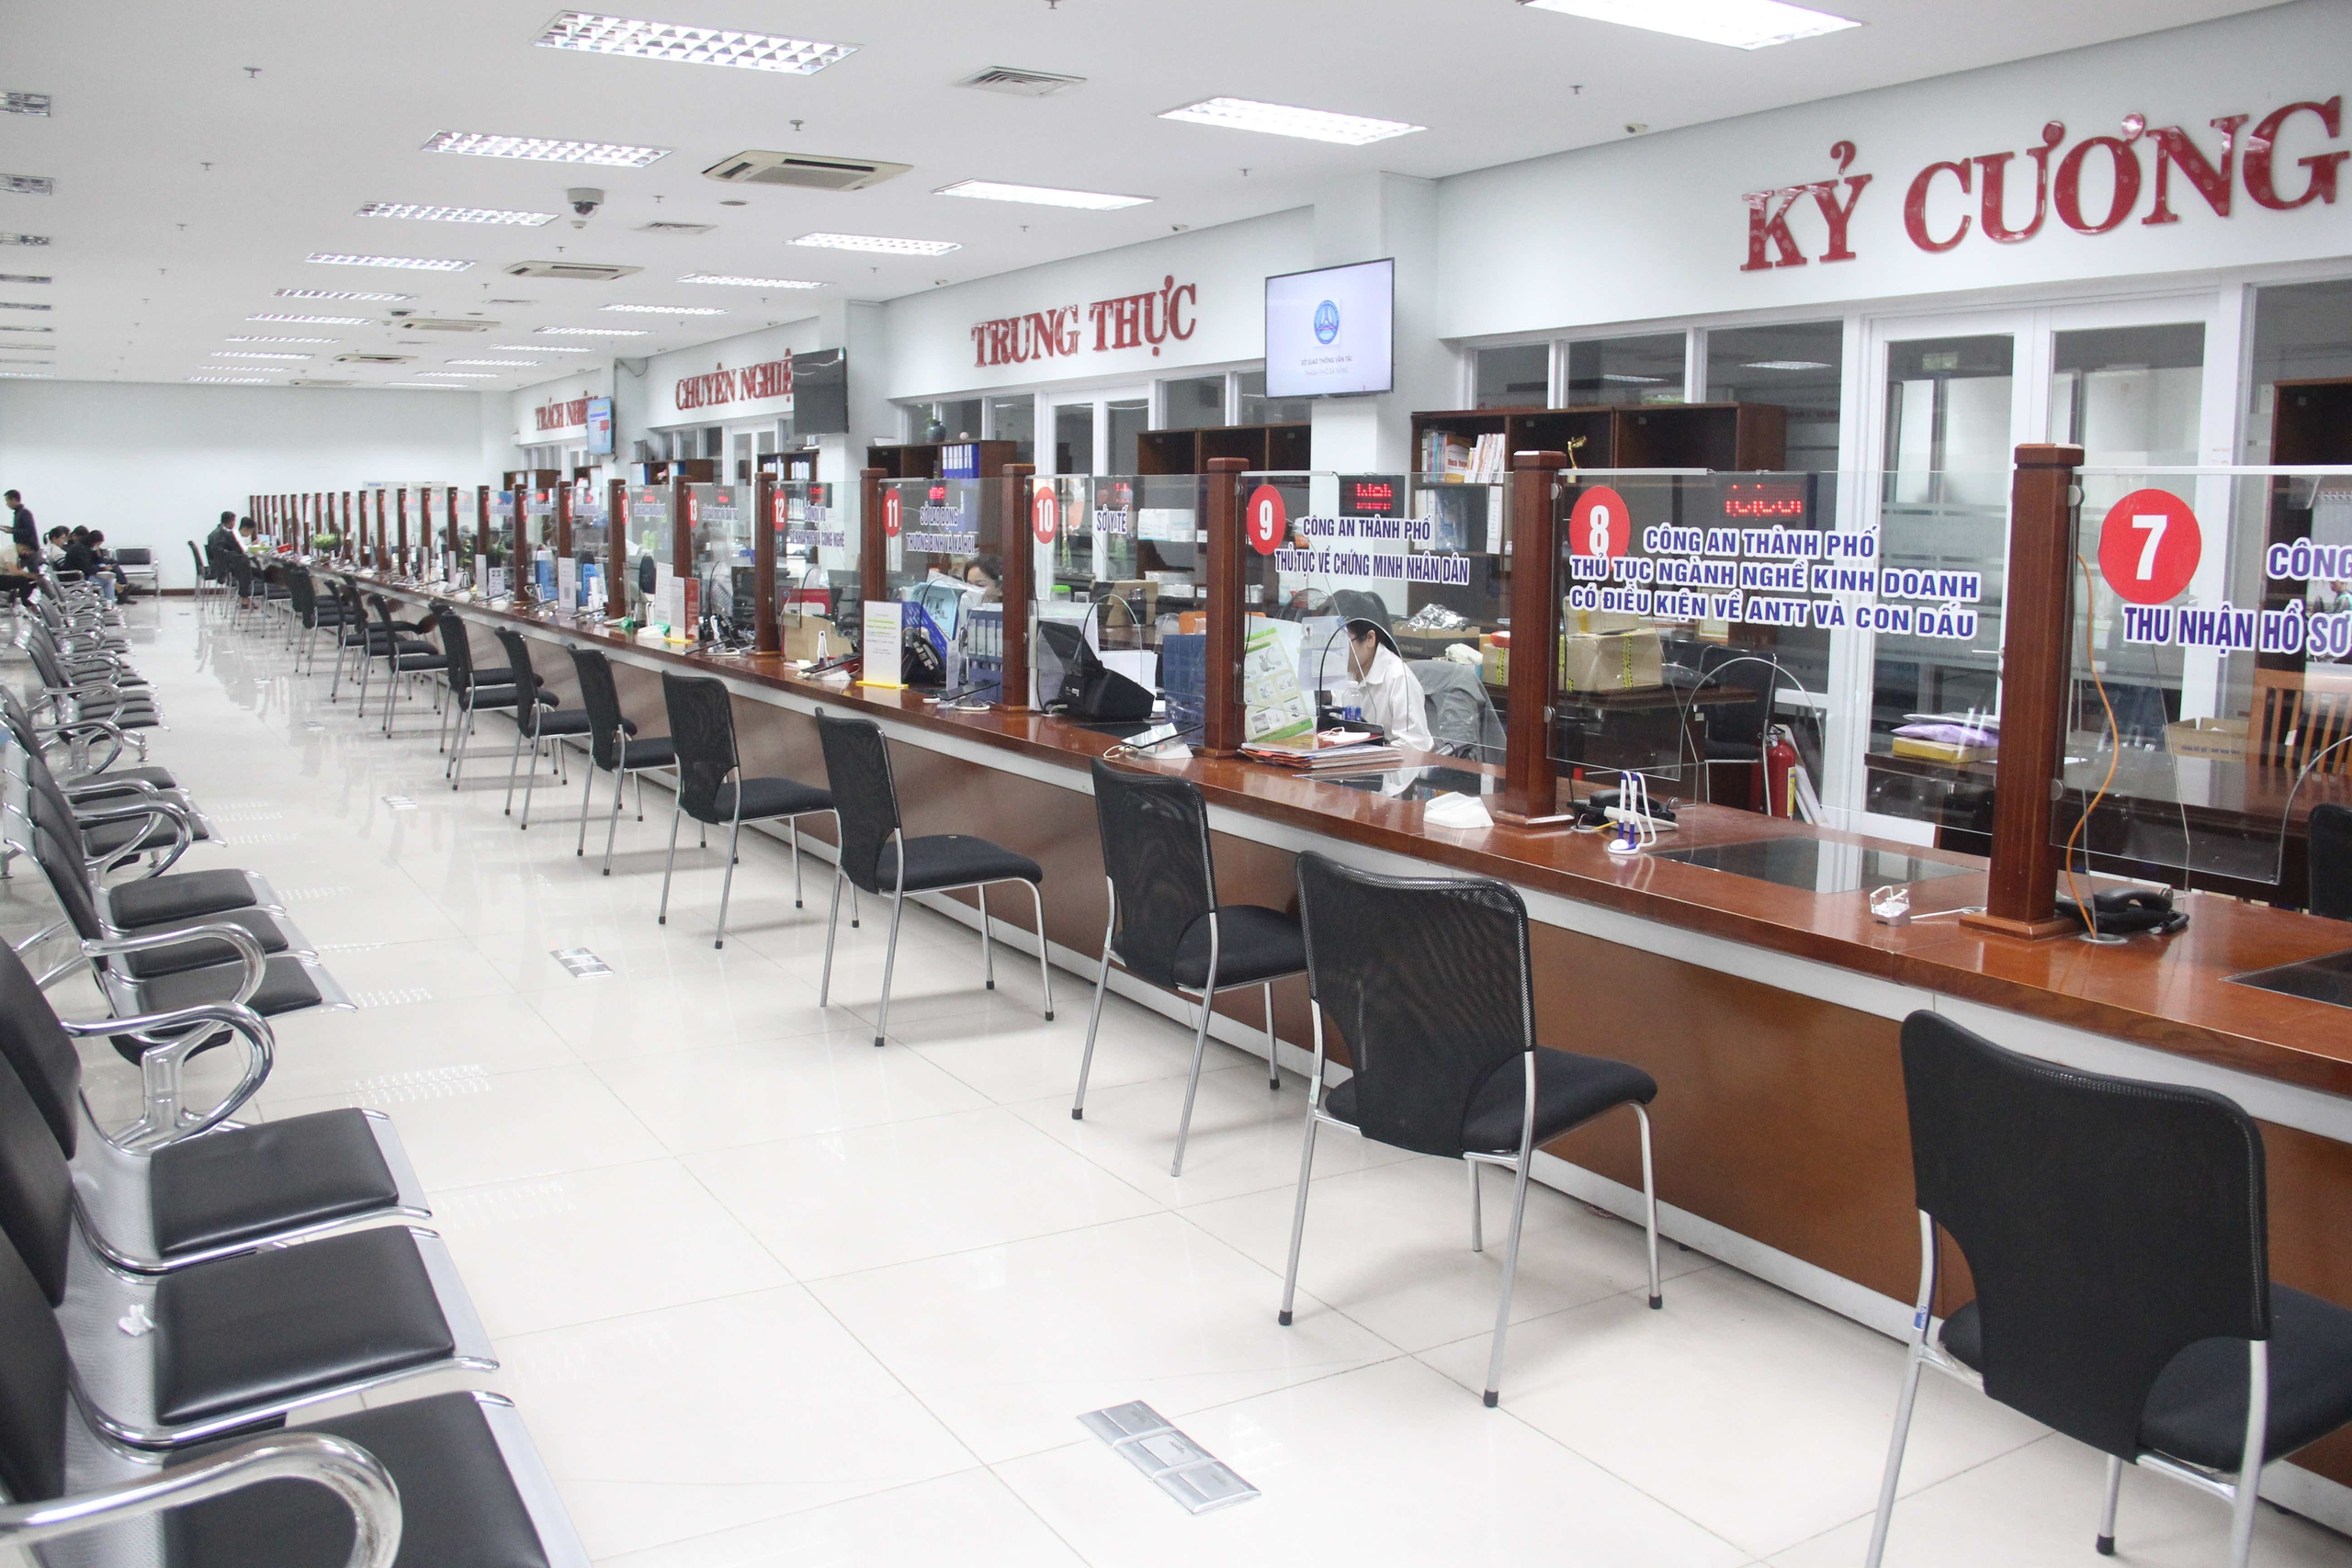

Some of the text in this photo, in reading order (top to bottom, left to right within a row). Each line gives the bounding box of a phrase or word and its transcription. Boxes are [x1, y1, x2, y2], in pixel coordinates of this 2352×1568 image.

[1741, 96, 2350, 271] KỶ CƯƠNG
[971, 276, 1196, 367] TRUNG THỰC
[675, 348, 794, 411] CHUYÊN NGHIỆ
[690, 499, 697, 521] 13
[775, 498, 785, 523] 12
[887, 499, 899, 528] 11
[1036, 499, 1053, 533] 10
[1097, 505, 1107, 531] SỞ
[1259, 499, 1272, 540] 9
[1303, 514, 1432, 541] CÔNG AN THÀNH PHỐ
[1589, 505, 1610, 557] 8
[1645, 525, 1879, 558] CÔNG AN THÀNH PHỐ
[2132, 514, 2167, 581] 7
[1275, 543, 1469, 584] THỦ TỤC VỀ CHỨNG MINH NHÂN DÂN
[1571, 555, 1978, 598] THỦ TỤC NGÀNH NGHỀ KINH DOANH
[2269, 540, 2352, 578] CÔNG
[1571, 581, 1973, 637] CÓ ĐIỀU KIỆN VỀ ANTT VÀ CON DẤU
[2123, 606, 2170, 642] THU
[2179, 605, 2254, 654] NHẬN
[2263, 603, 2306, 652] HỒ
